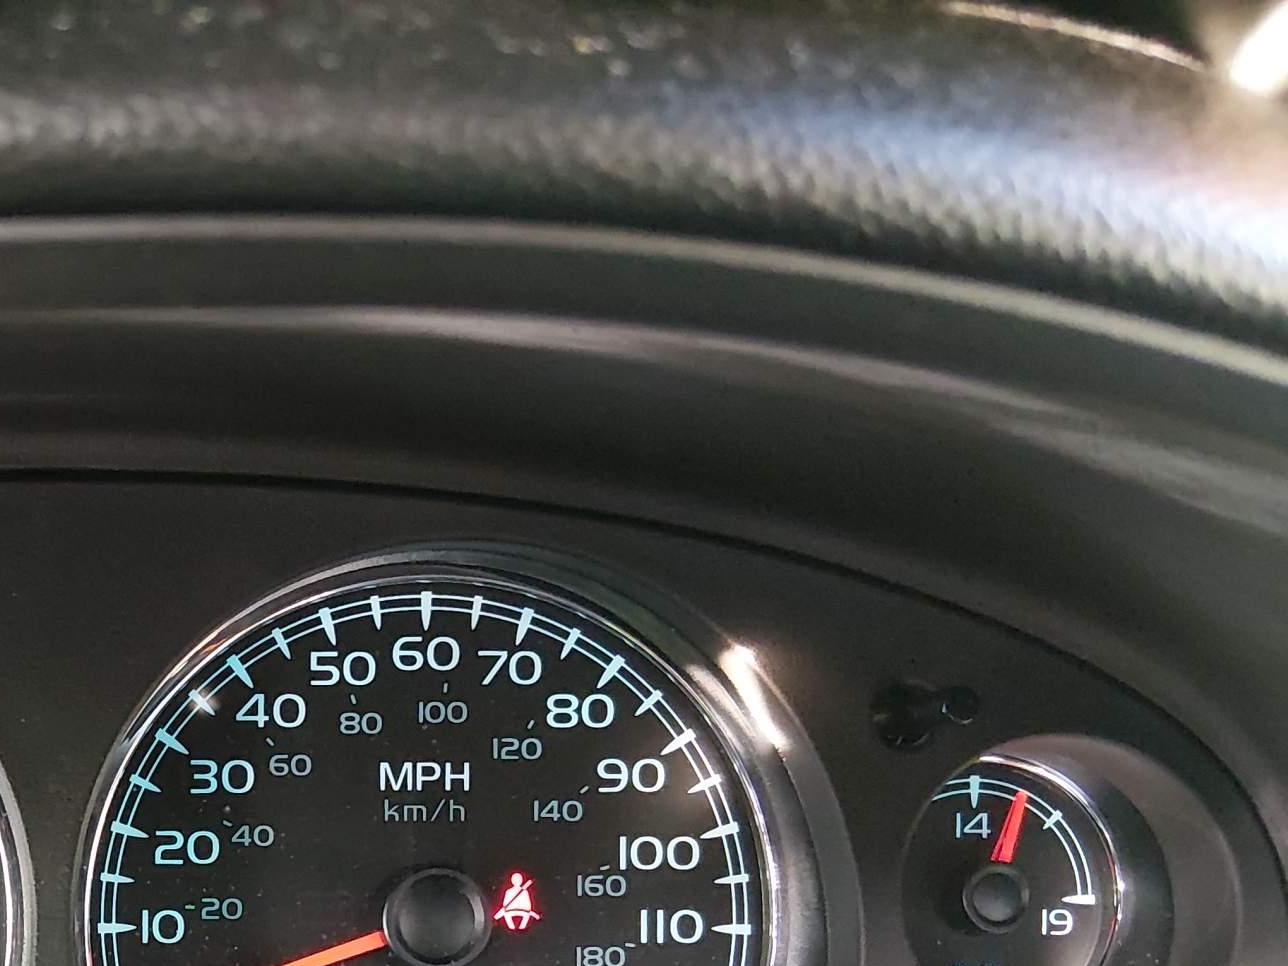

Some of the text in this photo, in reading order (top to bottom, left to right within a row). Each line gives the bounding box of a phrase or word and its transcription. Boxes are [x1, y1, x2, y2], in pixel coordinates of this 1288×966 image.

[393, 637, 460, 670] 60
[478, 651, 541, 684] 70
[311, 652, 375, 685] 50
[236, 694, 305, 727] 40
[340, 713, 382, 734] 80
[419, 702, 467, 723] 100
[547, 694, 614, 728] 80
[493, 738, 542, 759] 120
[191, 760, 254, 793] 30
[270, 755, 311, 775] 60
[380, 762, 469, 791] MPH
[597, 759, 665, 792] 90
[385, 799, 464, 821] km/h
[534, 800, 582, 821] 140
[232, 826, 274, 846] 40
[956, 813, 991, 838] 14
[155, 831, 219, 864] 20
[620, 836, 699, 870] 100
[578, 875, 626, 896] 160
[202, 898, 242, 919] 20
[1042, 909, 1073, 935] 19
[142, 910, 184, 943] 10
[641, 910, 703, 943] 110
